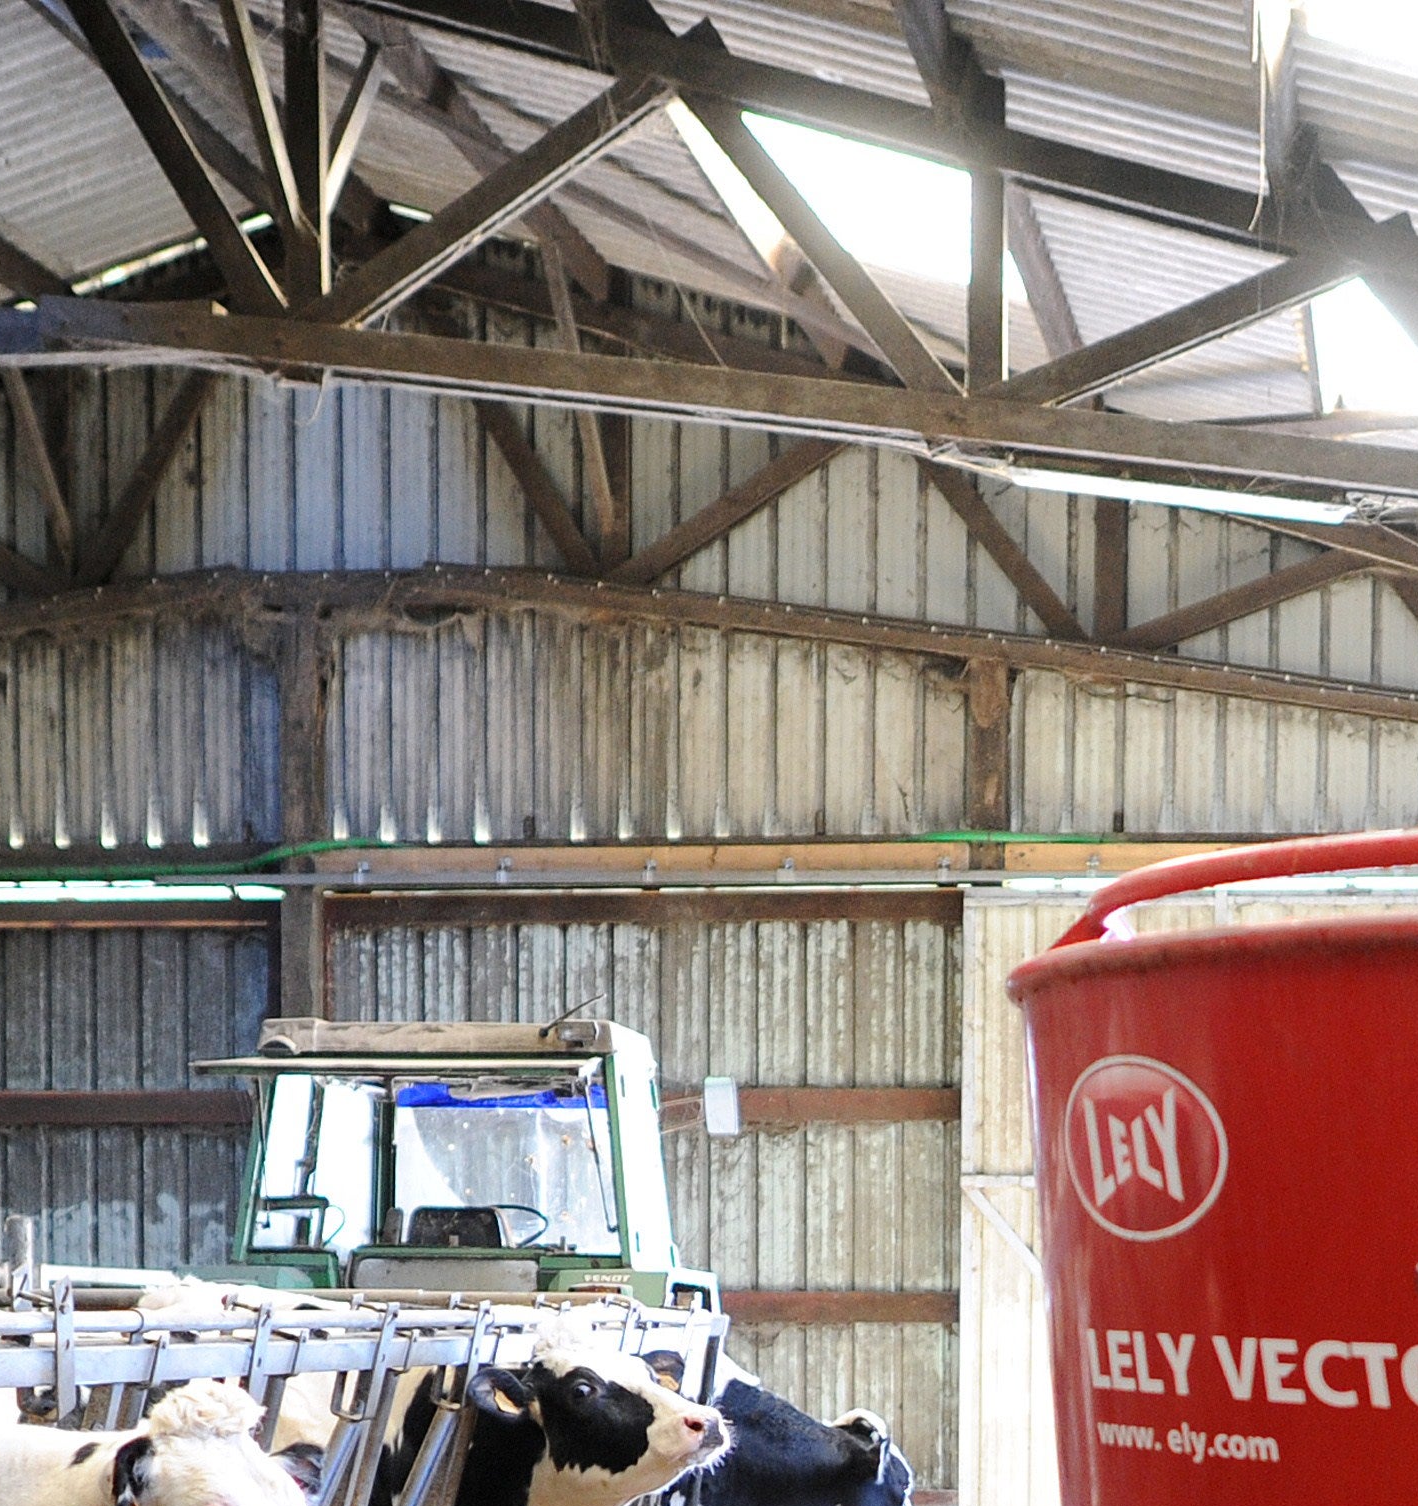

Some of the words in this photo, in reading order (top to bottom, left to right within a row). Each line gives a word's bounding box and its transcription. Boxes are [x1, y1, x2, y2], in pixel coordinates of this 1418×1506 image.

[1083, 1087, 1185, 1207] LELY
[584, 1274, 631, 1283] FENDT
[1087, 1328, 1195, 1396] LELY
